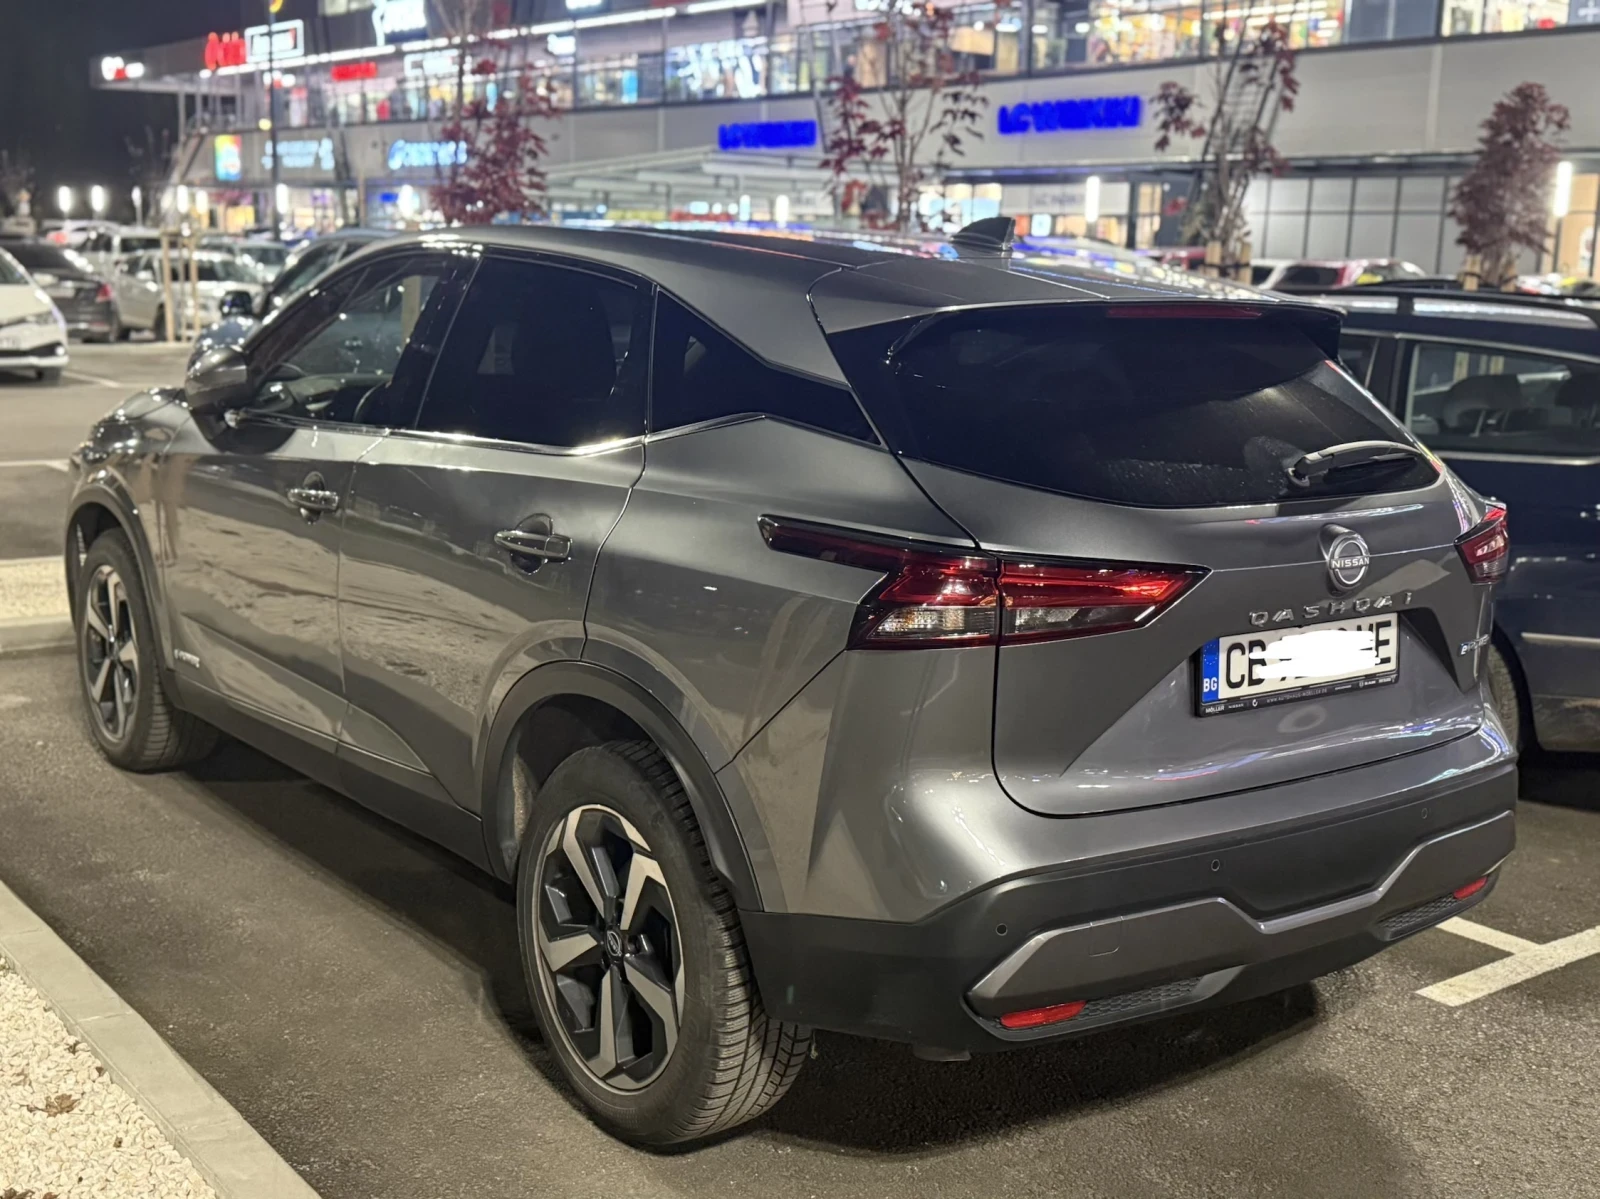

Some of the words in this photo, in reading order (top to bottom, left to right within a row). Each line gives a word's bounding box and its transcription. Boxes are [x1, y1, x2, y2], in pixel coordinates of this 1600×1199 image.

[1331, 556, 1370, 570] NISSAN
[1249, 592, 1412, 627] QASHQAI
[1203, 677, 1217, 693] BG
